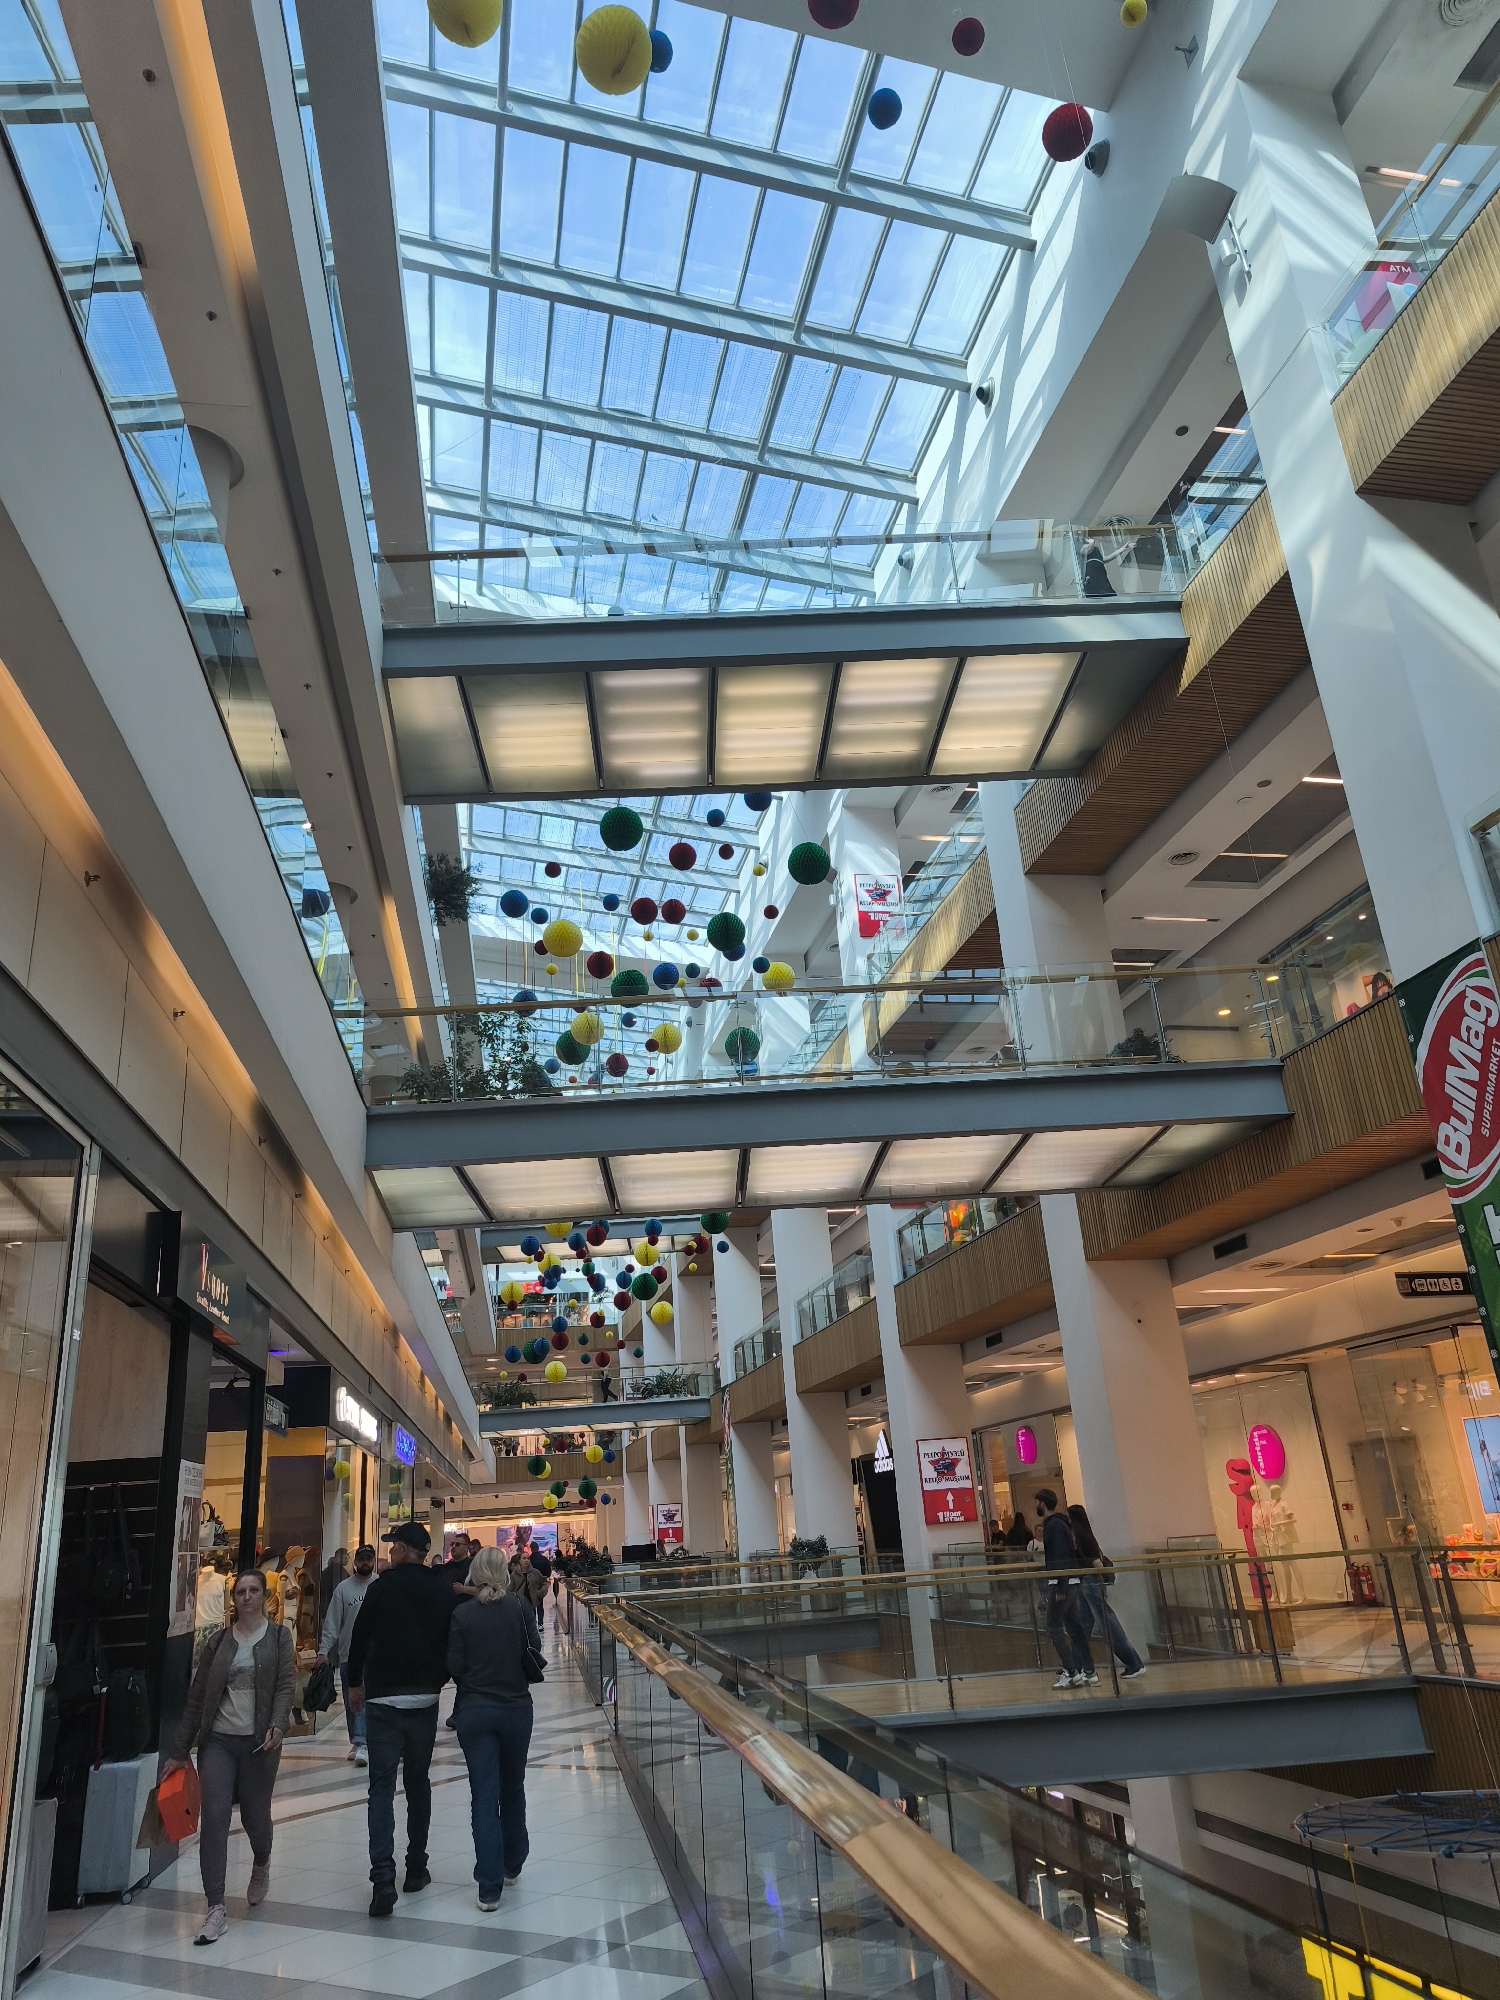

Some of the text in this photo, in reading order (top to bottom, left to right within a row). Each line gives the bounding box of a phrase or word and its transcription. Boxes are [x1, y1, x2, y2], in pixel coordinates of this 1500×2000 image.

[1389, 264, 1412, 274] ATM
[1437, 985, 1499, 1174] BulMag
[1480, 1037, 1500, 1138] SUPERMARKET
[944, 1449, 965, 1458] МУЗЕЙ
[874, 1458, 893, 1473] adidas
[944, 1474, 971, 1483] MUSEUM
[936, 1511, 943, 1523] 1
